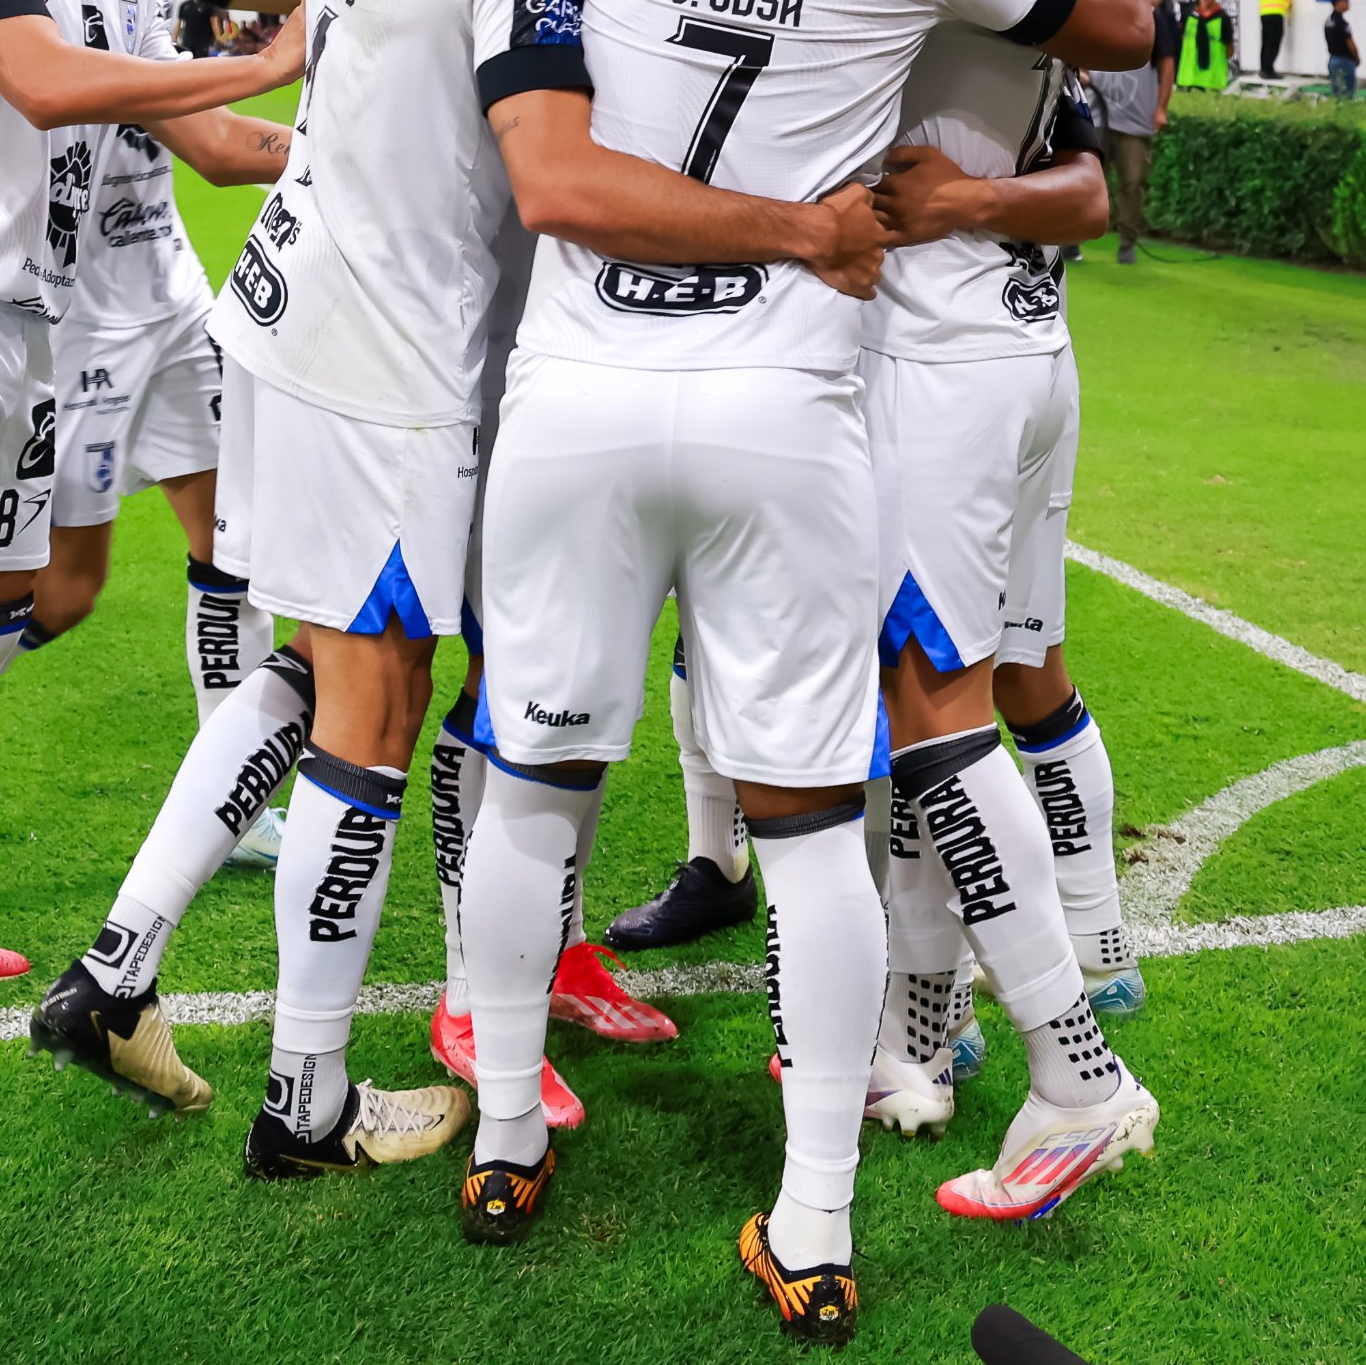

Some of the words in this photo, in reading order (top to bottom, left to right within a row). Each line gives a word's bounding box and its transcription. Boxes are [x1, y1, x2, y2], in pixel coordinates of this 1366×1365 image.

[665, 16, 777, 184] 7
[524, 700, 591, 727] Keuka
[308, 805, 387, 942] PERDUR
[431, 745, 467, 887] PERDURA
[918, 774, 1017, 926] PERDURA
[1034, 759, 1092, 857] PERDUR
